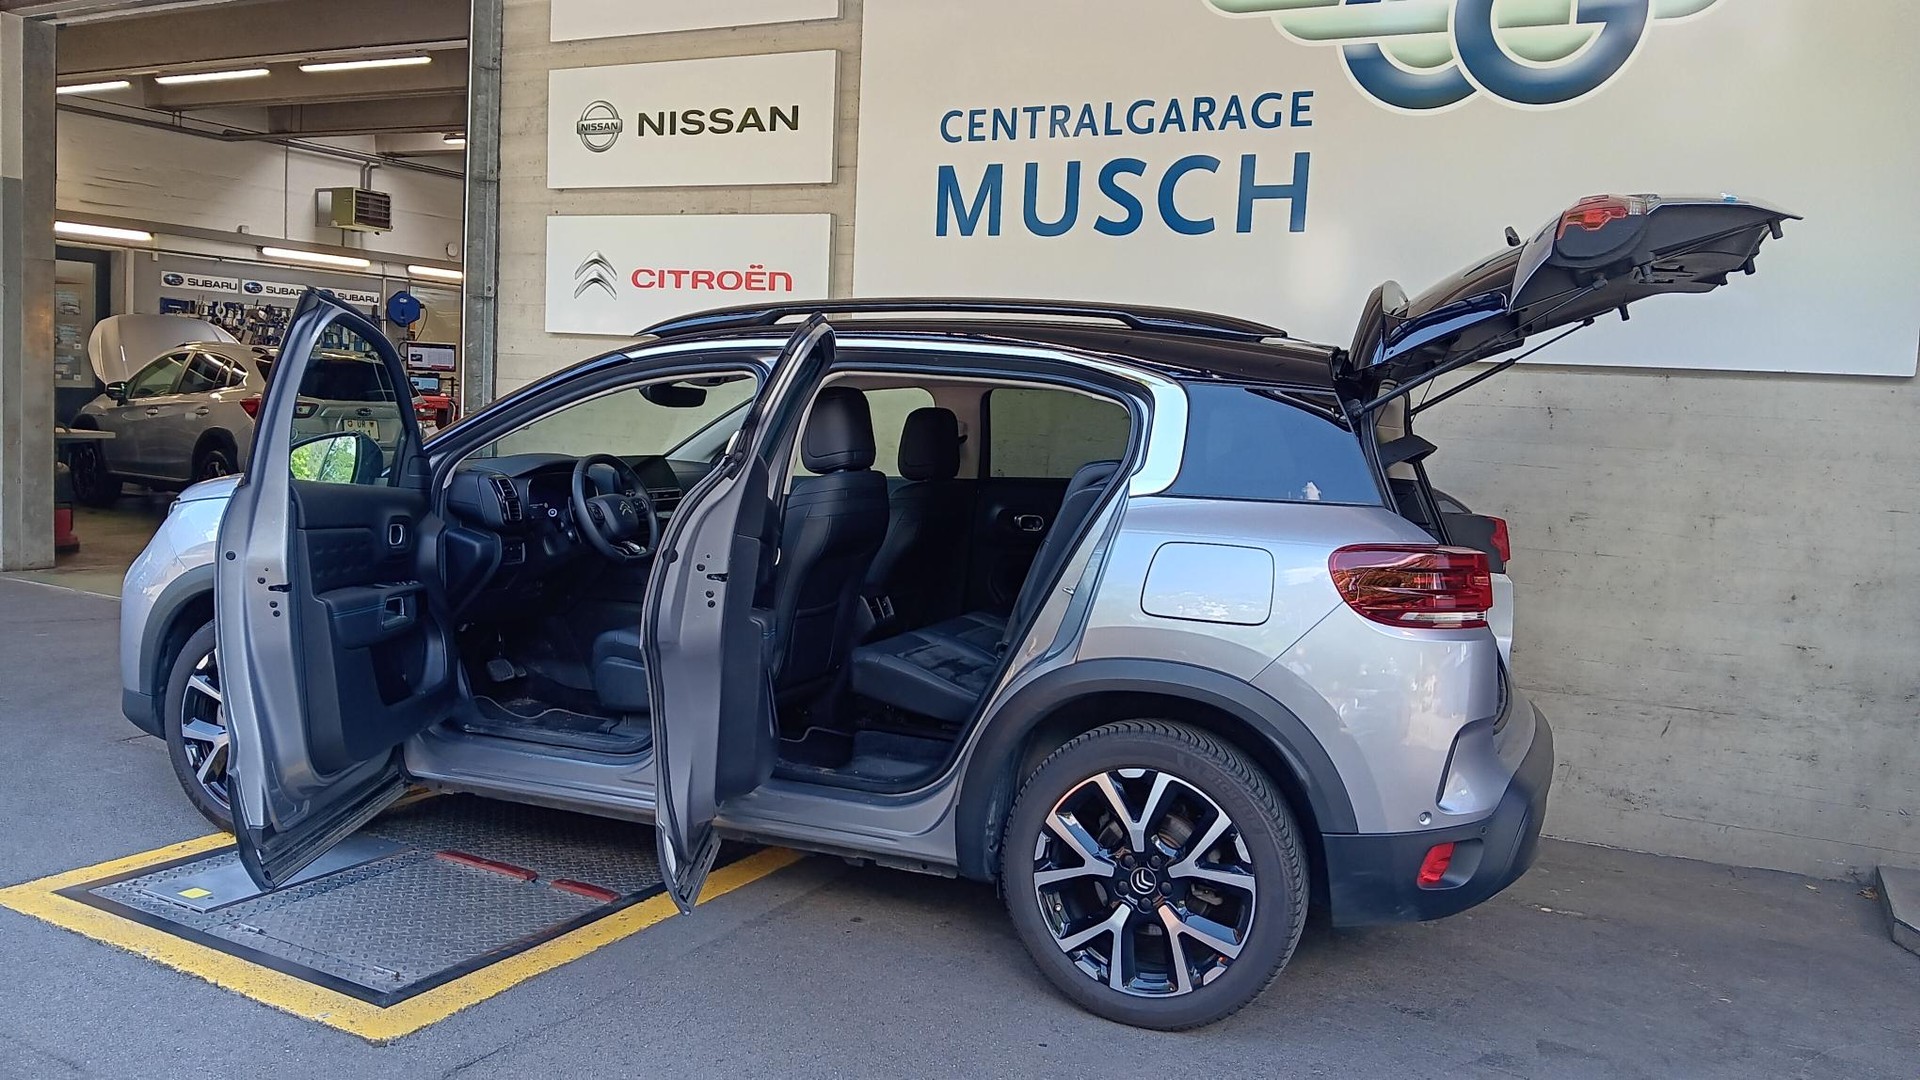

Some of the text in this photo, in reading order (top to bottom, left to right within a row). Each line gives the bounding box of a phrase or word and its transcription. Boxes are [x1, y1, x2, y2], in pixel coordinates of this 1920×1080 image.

[580, 105, 799, 137] NISSAN NISSAN
[939, 90, 1314, 143] CENTRALGARAGE
[936, 151, 1311, 237] MUSCH
[187, 278, 238, 290] SUBARU
[265, 285, 304, 296] SUBAR
[337, 292, 379, 304] SUBARU
